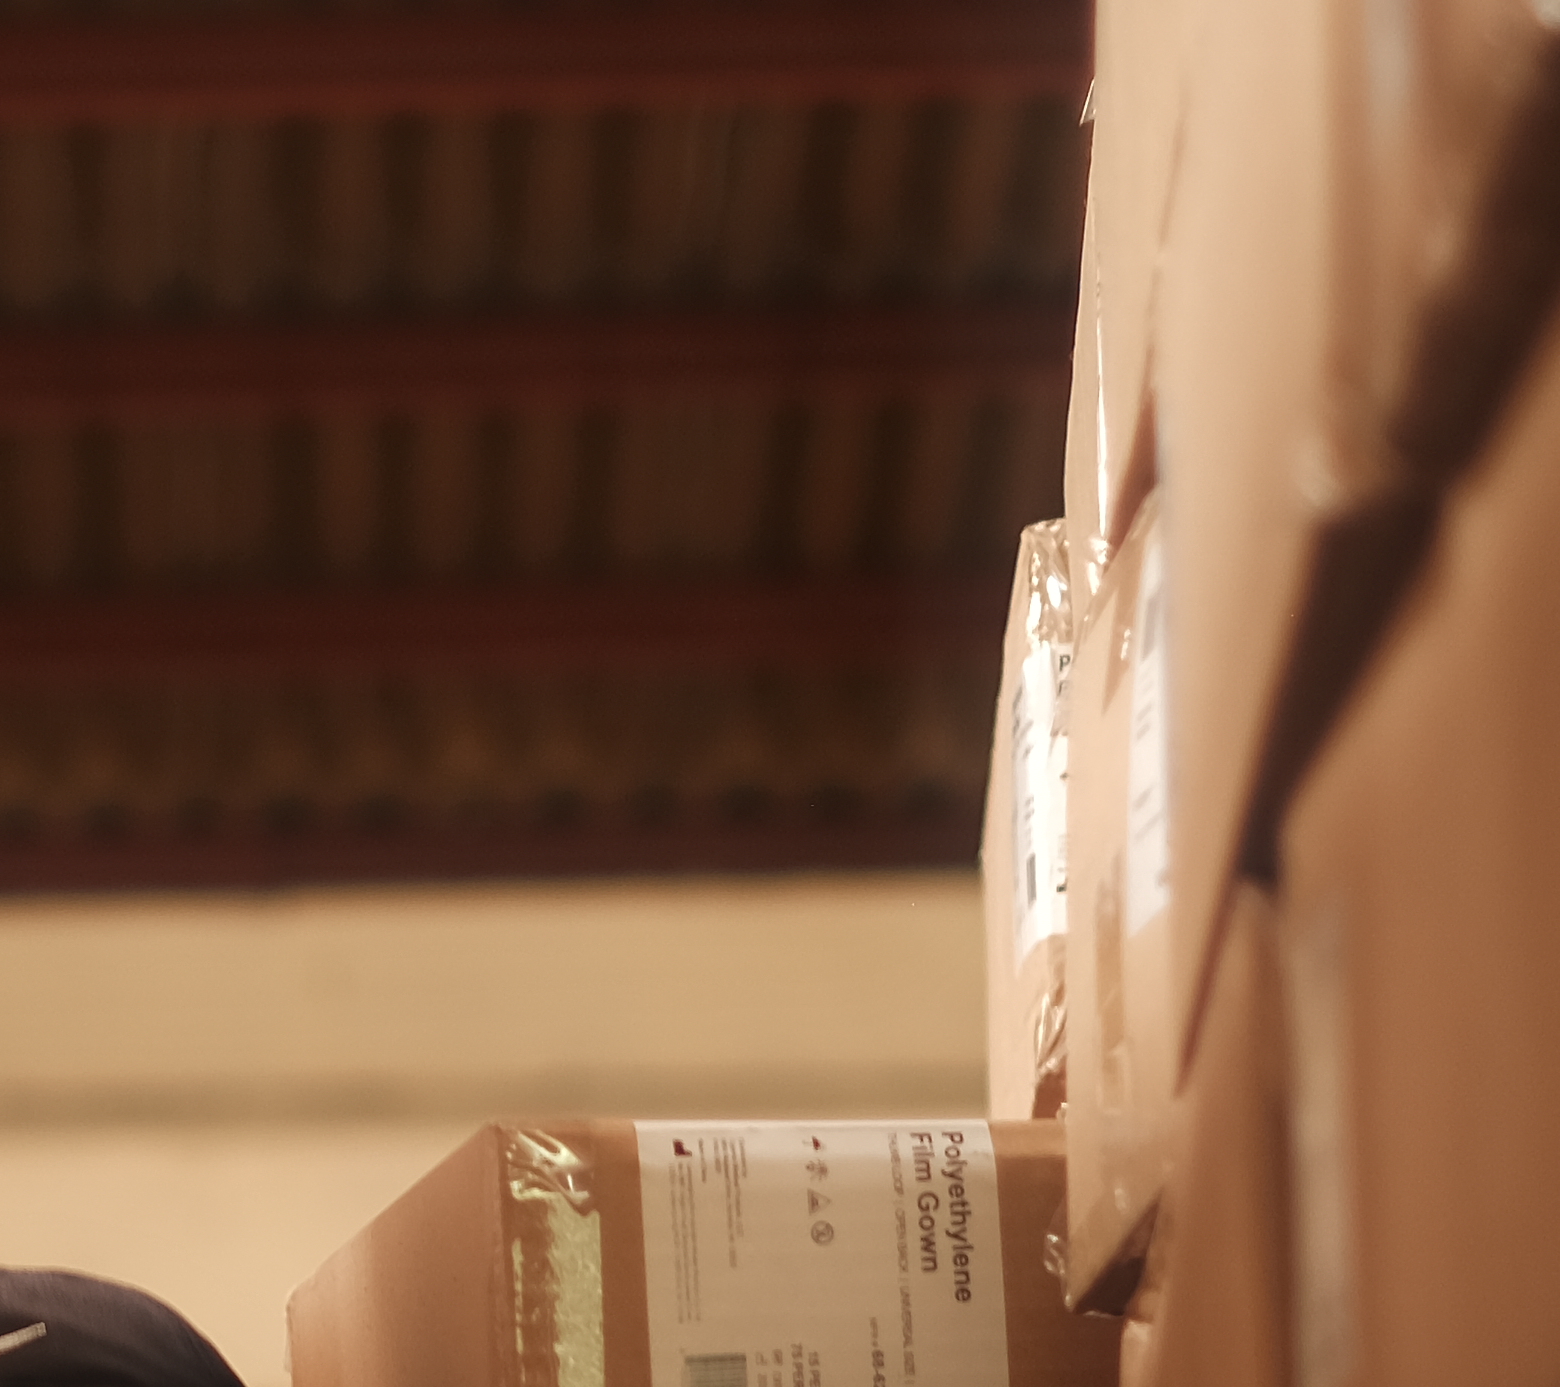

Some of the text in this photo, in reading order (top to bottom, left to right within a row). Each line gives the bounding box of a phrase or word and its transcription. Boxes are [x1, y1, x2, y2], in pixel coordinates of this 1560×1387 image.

[910, 1132, 939, 1272] Film Gown
[941, 1131, 973, 1303] Polyethylene
